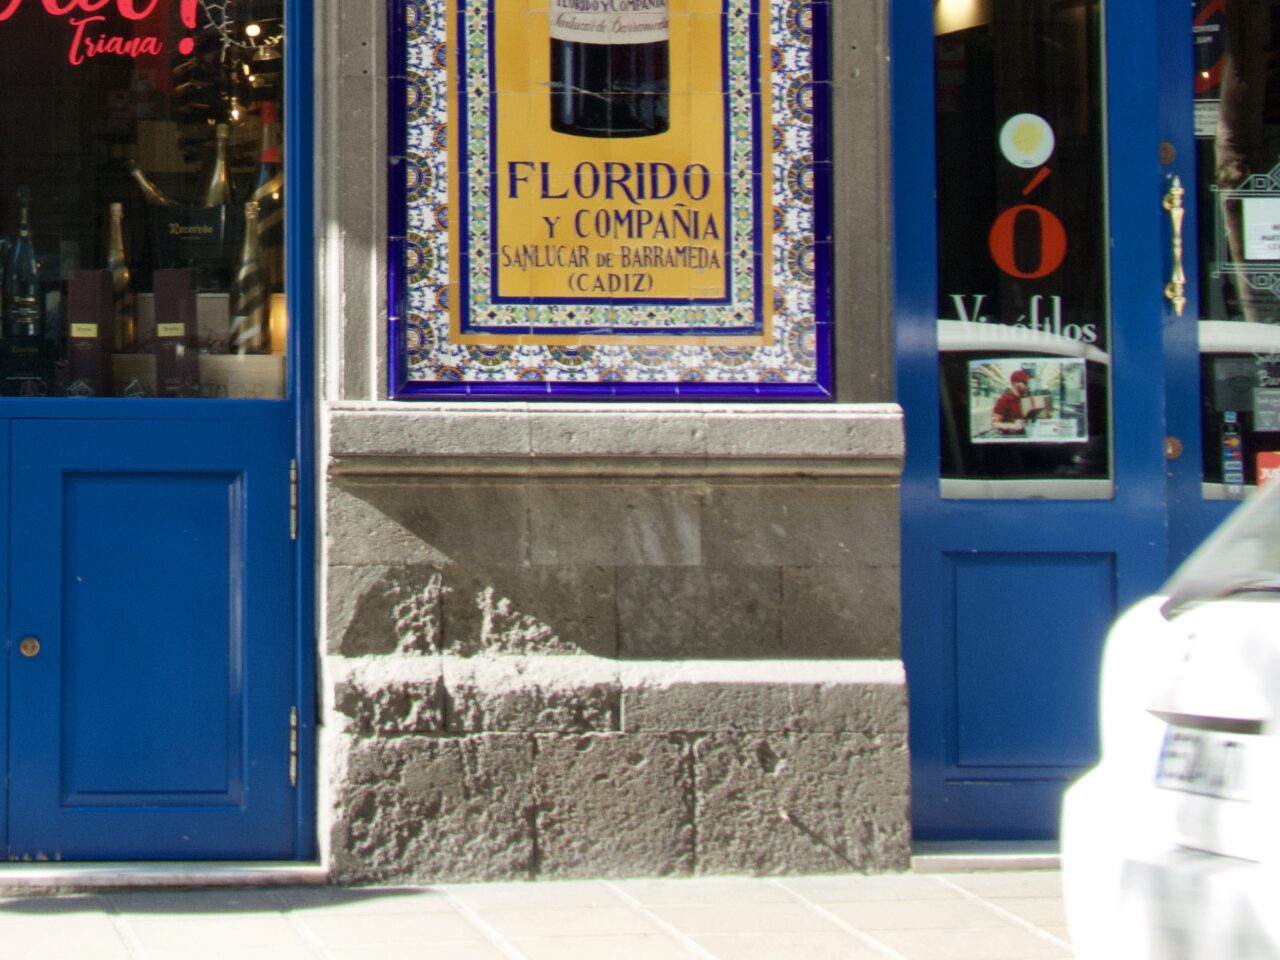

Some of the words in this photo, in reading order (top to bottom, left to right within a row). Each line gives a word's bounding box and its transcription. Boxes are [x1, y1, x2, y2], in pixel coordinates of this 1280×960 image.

[69, 15, 164, 66] Triana
[507, 161, 711, 205] FLORIDO
[542, 216, 561, 238] Y
[575, 203, 720, 240] COMPAÑIA
[501, 245, 589, 268] SANLUCAR
[597, 252, 614, 268] DE
[620, 246, 721, 269] BARRAMEDA
[568, 273, 654, 292] (CADIZ)
